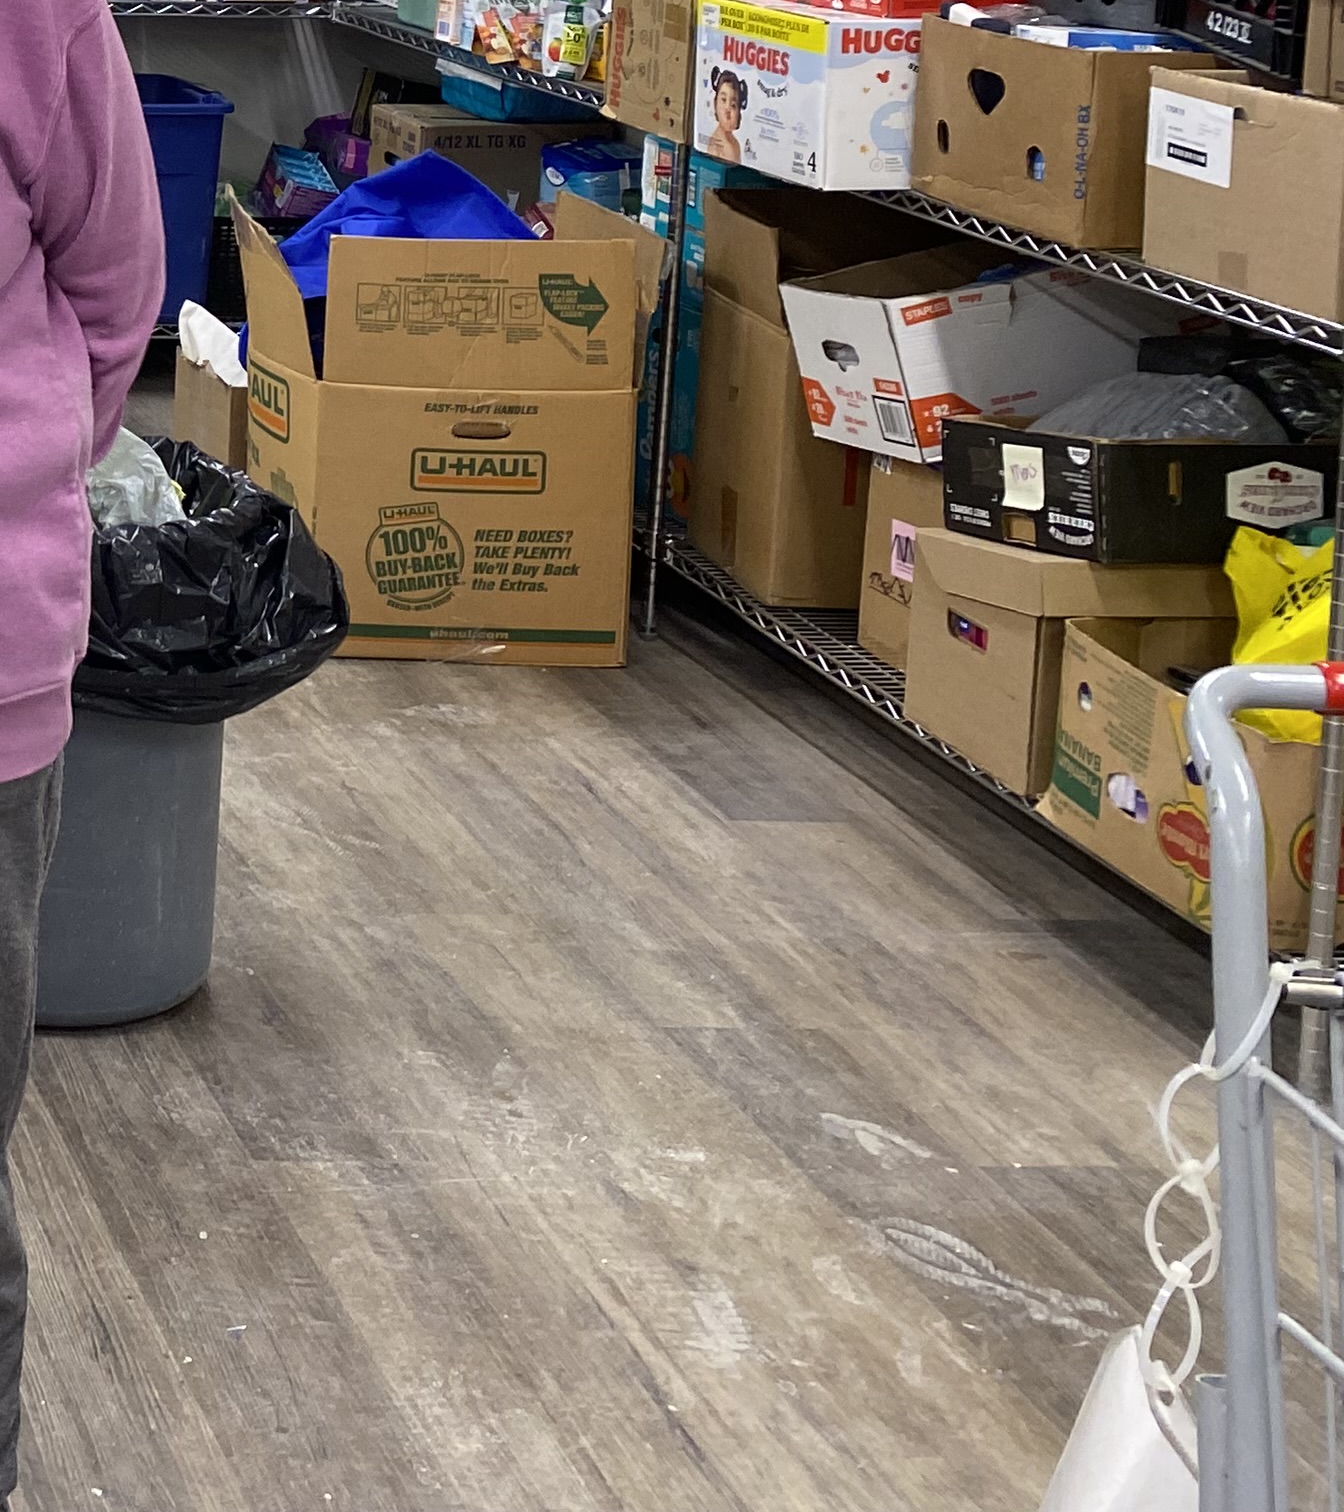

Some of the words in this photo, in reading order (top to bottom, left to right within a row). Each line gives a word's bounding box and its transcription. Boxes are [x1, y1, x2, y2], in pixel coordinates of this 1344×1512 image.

[608, 6, 627, 109] HUGGIES
[723, 35, 791, 76] HUGGIES
[434, 136, 463, 149] 4/12
[466, 135, 483, 149] XL
[487, 135, 505, 149] TG
[507, 135, 526, 149] XG
[806, 151, 817, 173] 4
[904, 299, 950, 321] STAPLES
[957, 293, 984, 304] copy
[424, 402, 491, 414] EASY-TO-LIFT
[493, 403, 539, 415] HANDLES
[420, 455, 537, 478] U-HAUL
[382, 505, 435, 519] U-HAUL
[1267, 500, 1317, 517] ORCHARD
[378, 525, 448, 557] 100%
[473, 529, 513, 543] NEED
[516, 529, 574, 544] BOXES?
[474, 546, 510, 559] TAKE
[513, 546, 571, 560] PLENTY!
[375, 552, 458, 578] BUY-BACK
[472, 562, 508, 575] We'll
[511, 562, 540, 578] Buy
[543, 563, 581, 576] Back
[377, 571, 461, 595] GUARANTEE
[471, 578, 496, 591] the
[499, 579, 549, 593] Extras.
